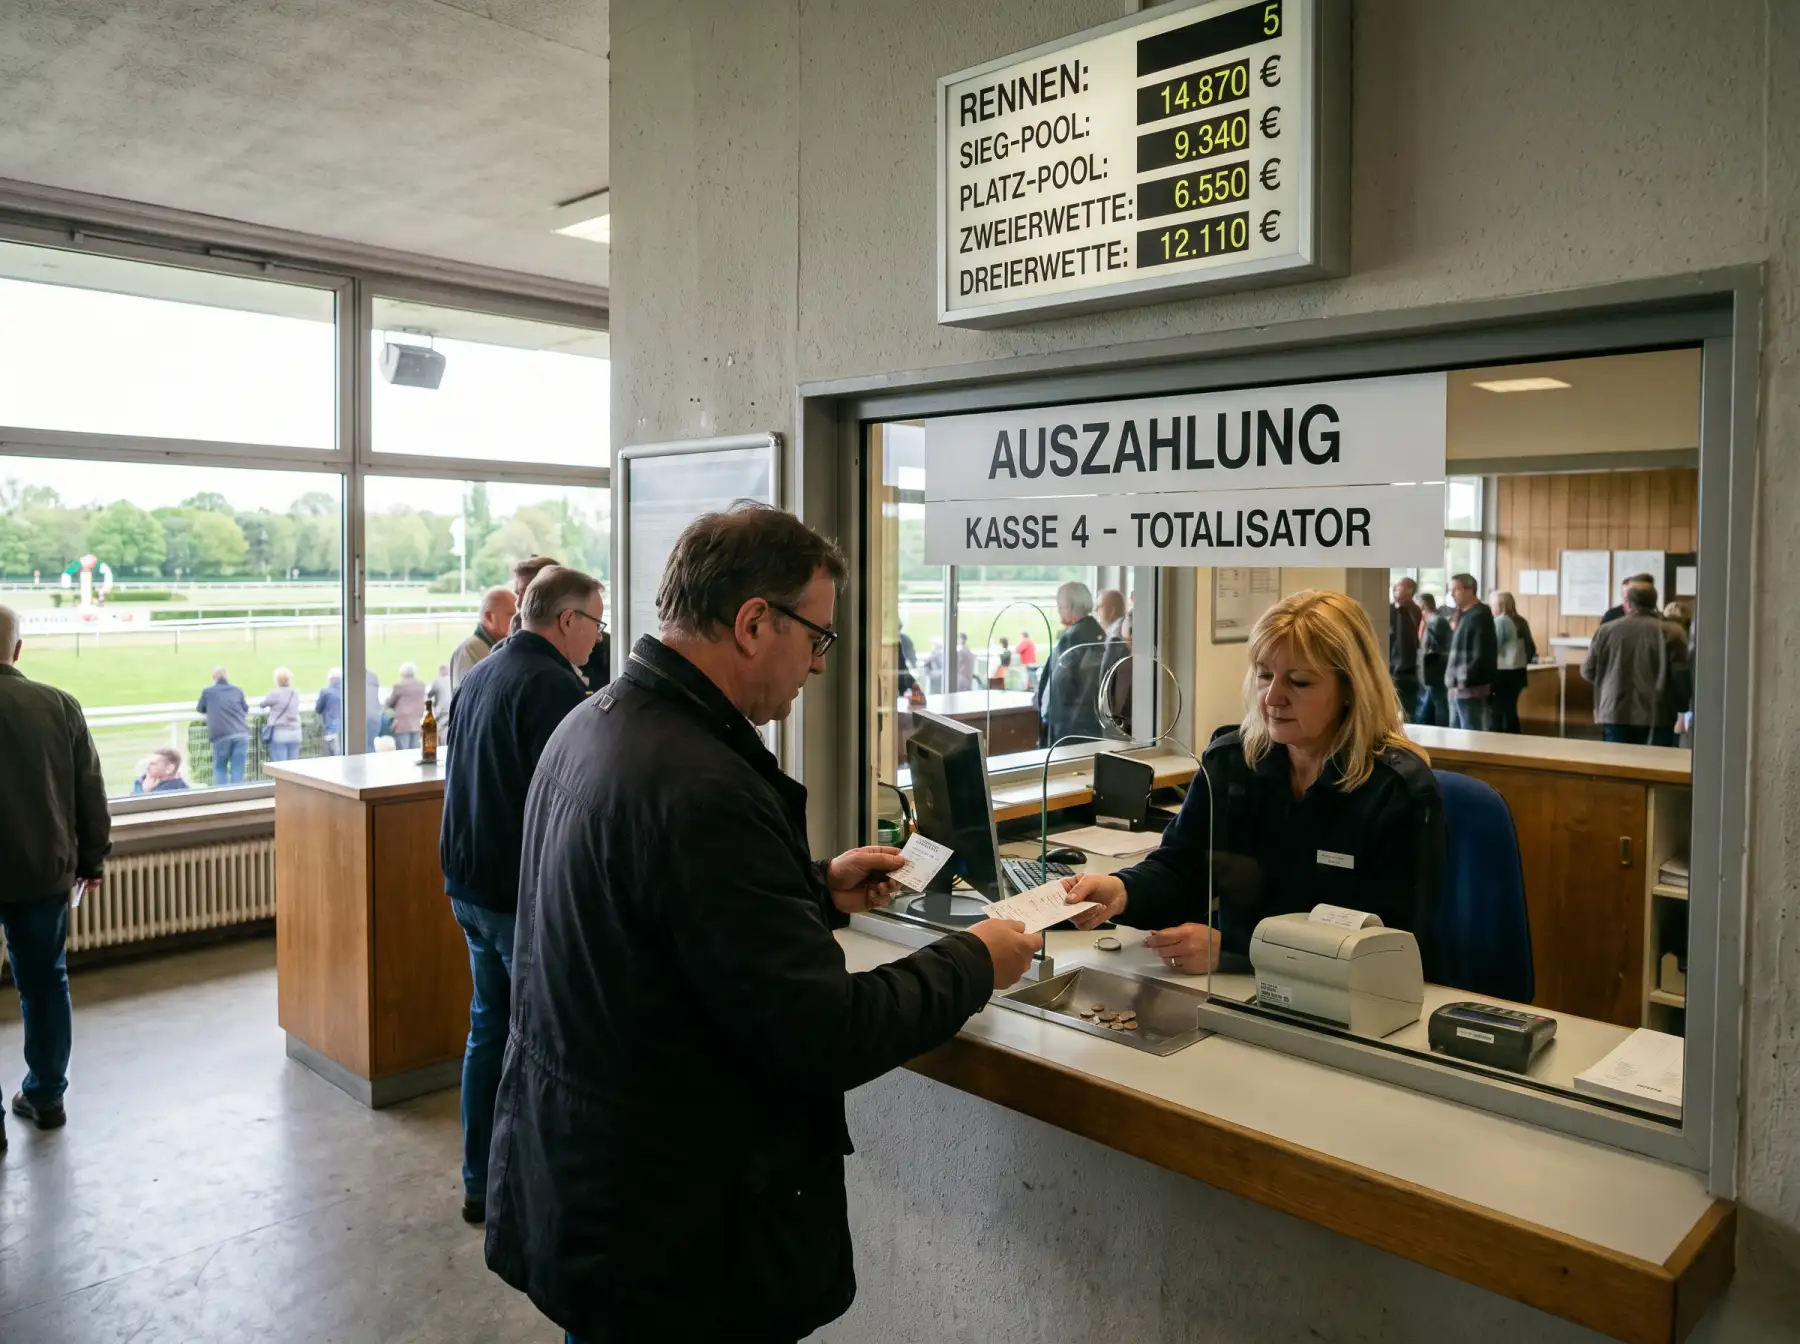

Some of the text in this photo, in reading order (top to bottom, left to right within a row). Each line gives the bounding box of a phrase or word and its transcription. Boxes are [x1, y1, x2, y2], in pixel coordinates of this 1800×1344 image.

[959, 54, 1282, 168] SIEG-POOL: 14.870 €
[960, 3, 1280, 127] RENNEN: 5
[959, 157, 1282, 254] ZWEIERWETTE: 6.550 €
[960, 105, 1282, 212] PLATZ-POOL: 9.340 €
[960, 209, 1282, 297] DREIERWETTE: 12.110 €
[988, 403, 1341, 480] AUSZAHLUNG
[965, 514, 1059, 549] KASSE
[1071, 514, 1090, 549] 4
[1130, 507, 1371, 549] TOTALISATOR
